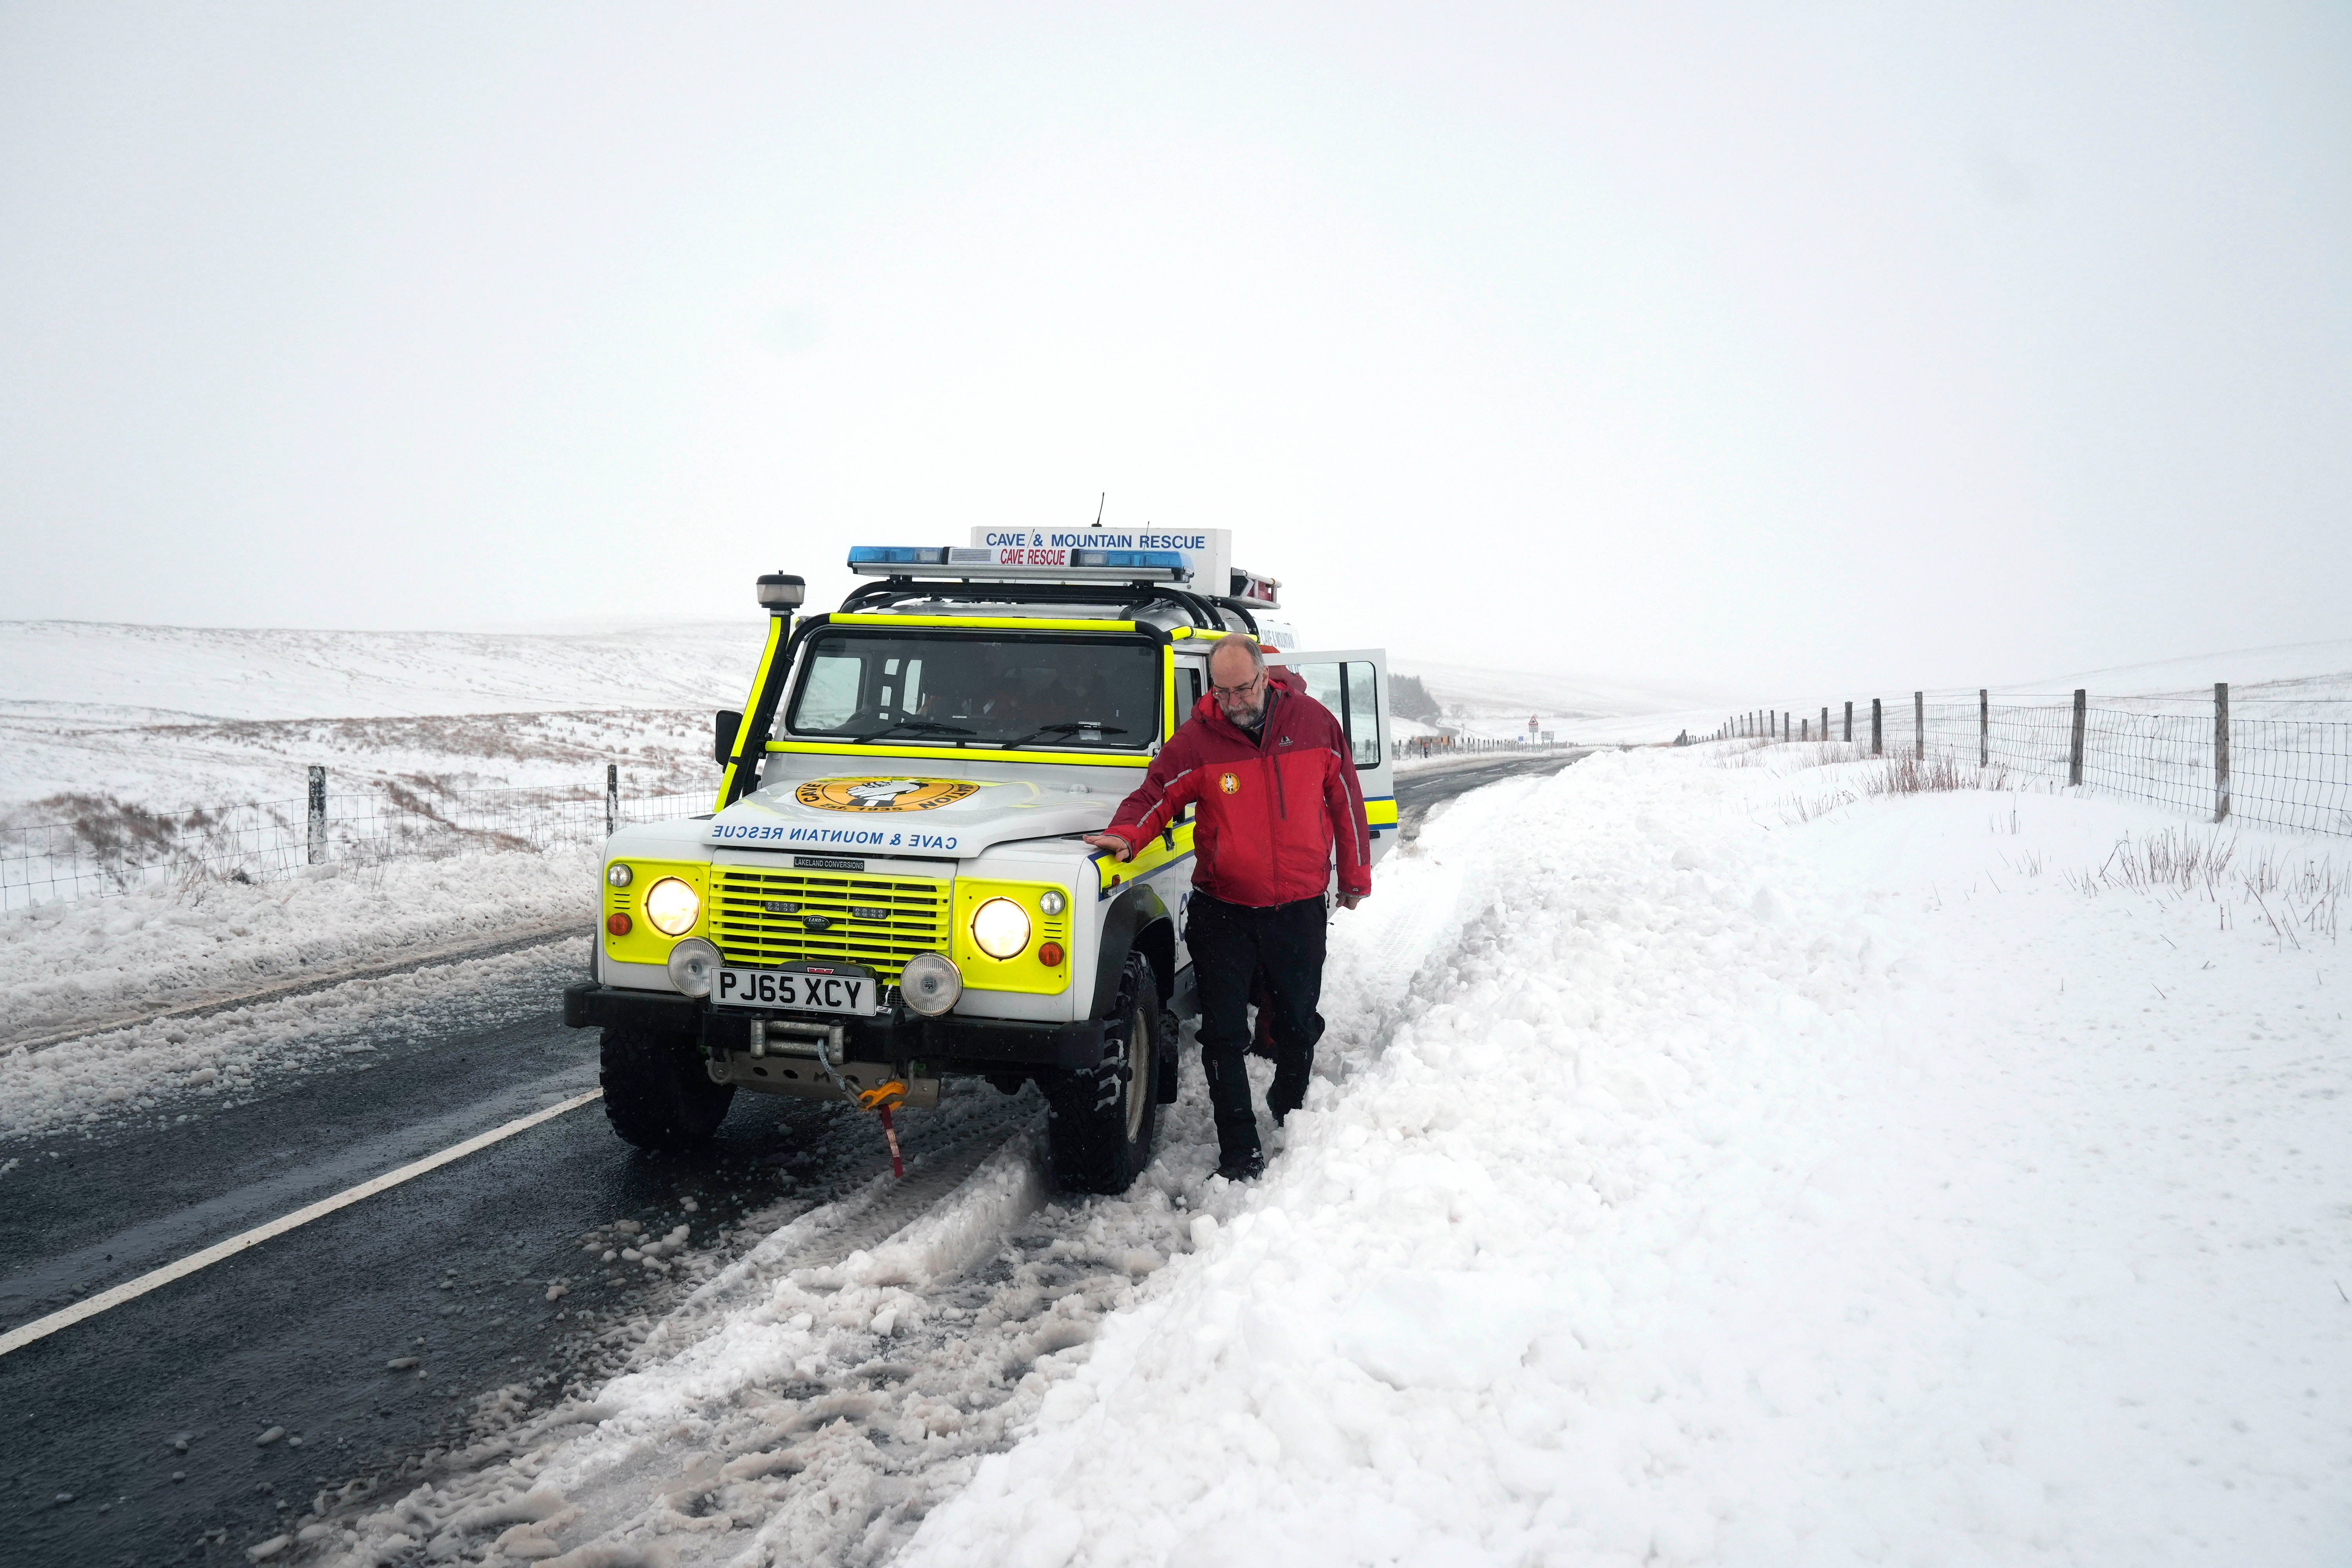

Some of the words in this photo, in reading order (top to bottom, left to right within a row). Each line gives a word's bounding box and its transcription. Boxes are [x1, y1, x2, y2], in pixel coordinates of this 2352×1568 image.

[986, 533, 1025, 546] CAVE
[1033, 534, 1043, 547] &
[1051, 534, 1132, 548] MOUNTAIN
[1140, 535, 1205, 549] RESCUE
[1000, 549, 1024, 564] CAVE
[1027, 549, 1065, 565] RESCUE
[1261, 629, 1274, 646] CAVE
[801, 784, 823, 802] CAVE
[795, 859, 824, 867] LAKELAND
[824, 860, 864, 869] CONVERSIONS
[720, 972, 795, 1004] PJ65
[805, 978, 861, 1009] XCY
